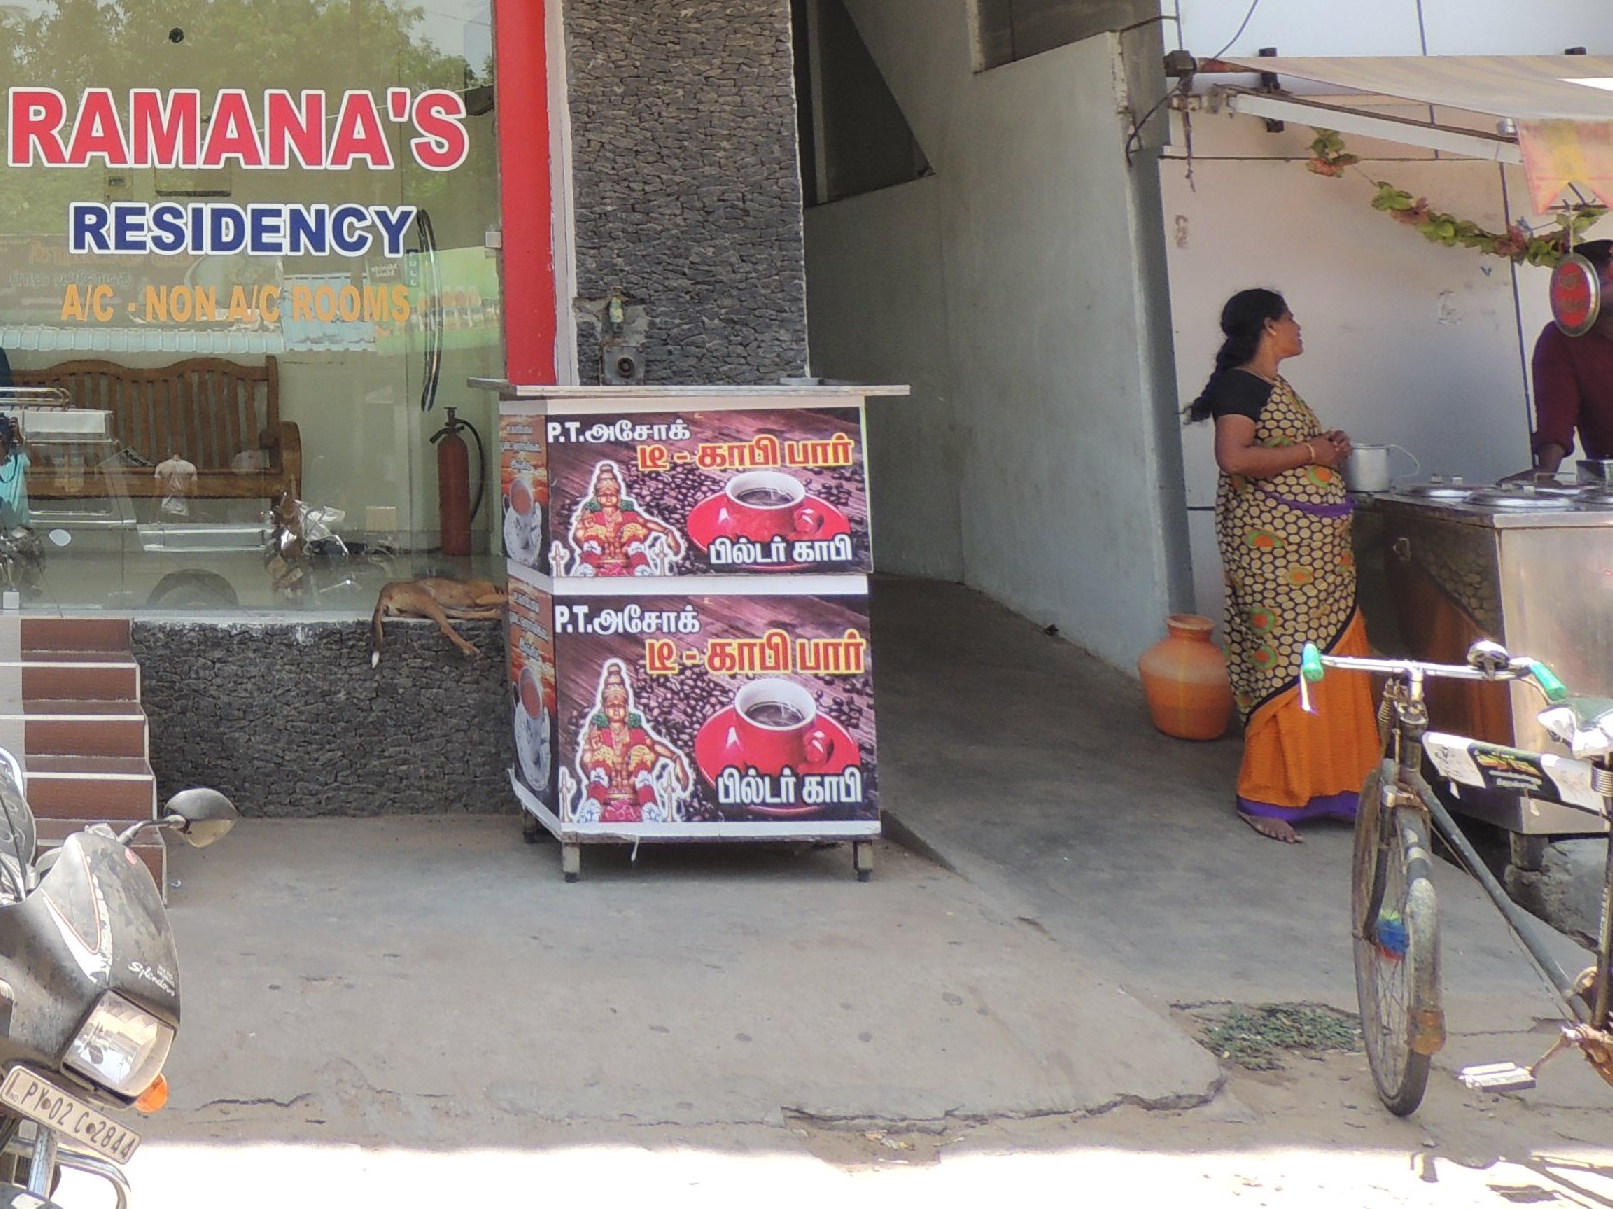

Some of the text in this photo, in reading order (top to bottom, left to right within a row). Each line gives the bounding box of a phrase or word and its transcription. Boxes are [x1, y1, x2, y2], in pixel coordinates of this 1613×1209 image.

[7, 86, 470, 172] RAMANA'S
[68, 202, 419, 257] RESIDENCY
[61, 283, 115, 322] A/C
[145, 284, 217, 322] NON
[228, 284, 281, 322] A/C
[292, 285, 412, 323] ROOMS
[696, 434, 781, 468] காபி
[785, 432, 854, 466] பார்
[709, 534, 853, 565] பில்டர் காபி
[705, 629, 791, 674] காபி
[798, 628, 867, 673] பார்
[716, 767, 863, 804] பில்டர் காபி
